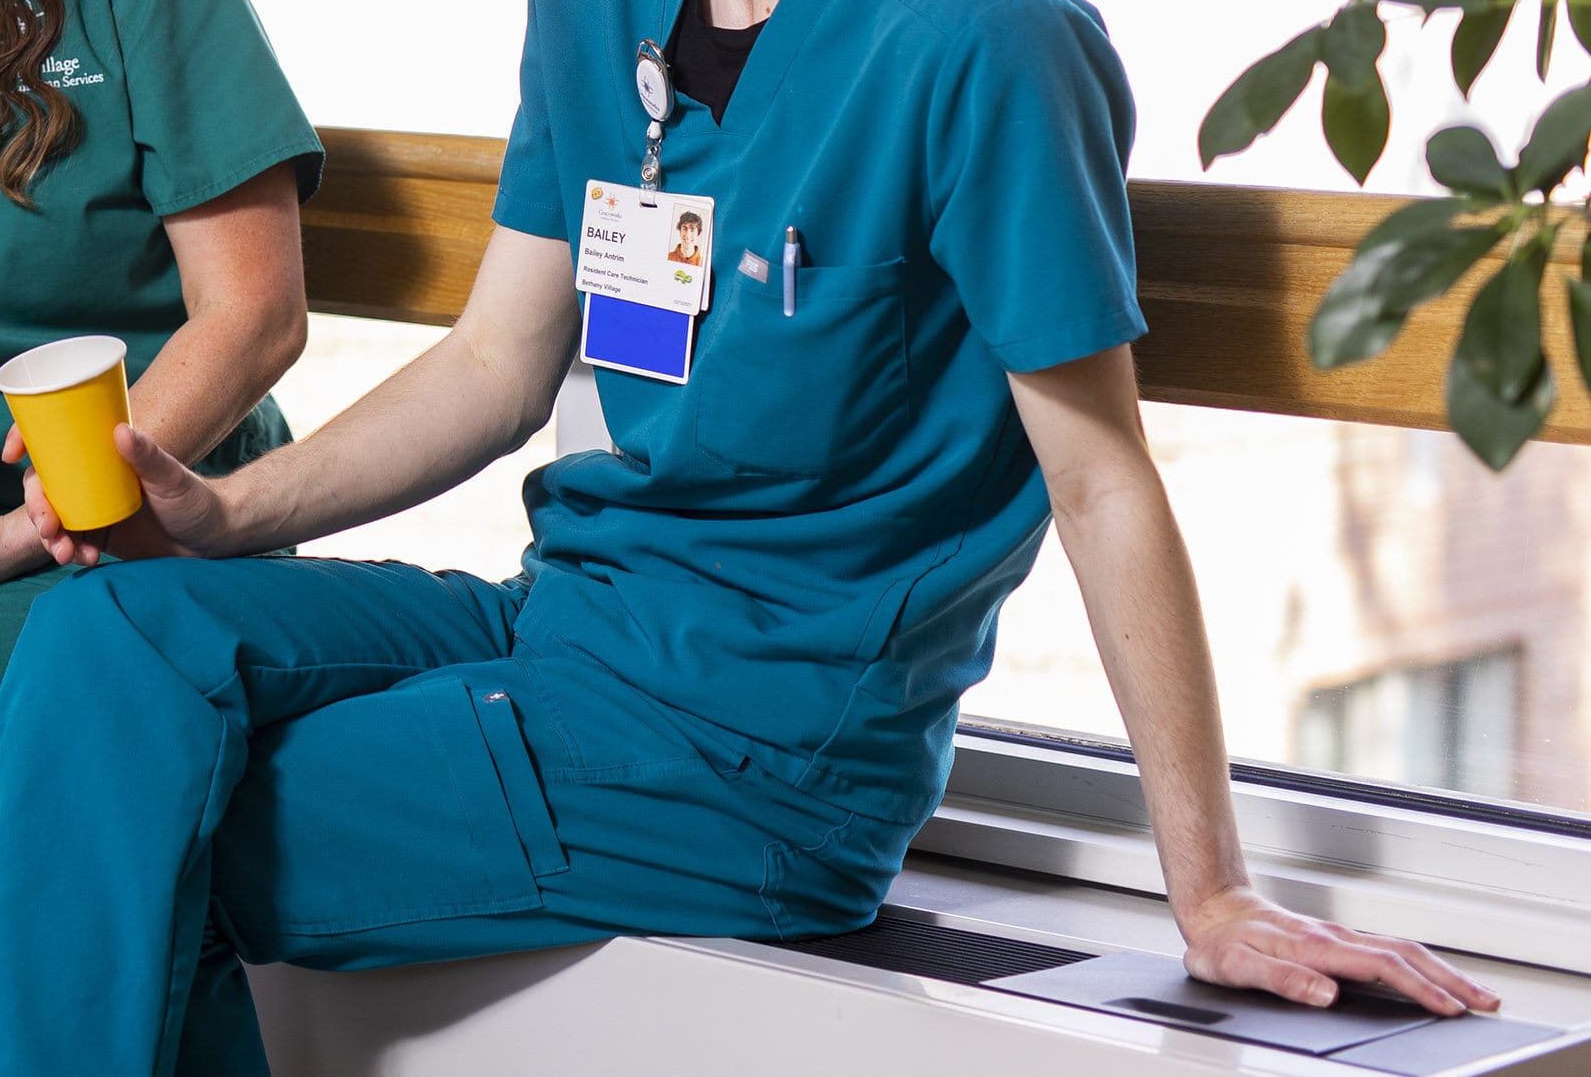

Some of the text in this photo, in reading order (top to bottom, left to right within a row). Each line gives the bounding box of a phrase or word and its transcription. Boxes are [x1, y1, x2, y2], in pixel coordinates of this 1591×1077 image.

[42, 57, 80, 75] illage
[62, 73, 104, 87] Services
[587, 226, 626, 244] BAILEY
[584, 248, 625, 262] Bailey Antrim
[583, 266, 648, 284] Resident Care Technician
[582, 279, 621, 293] Bethany Village
